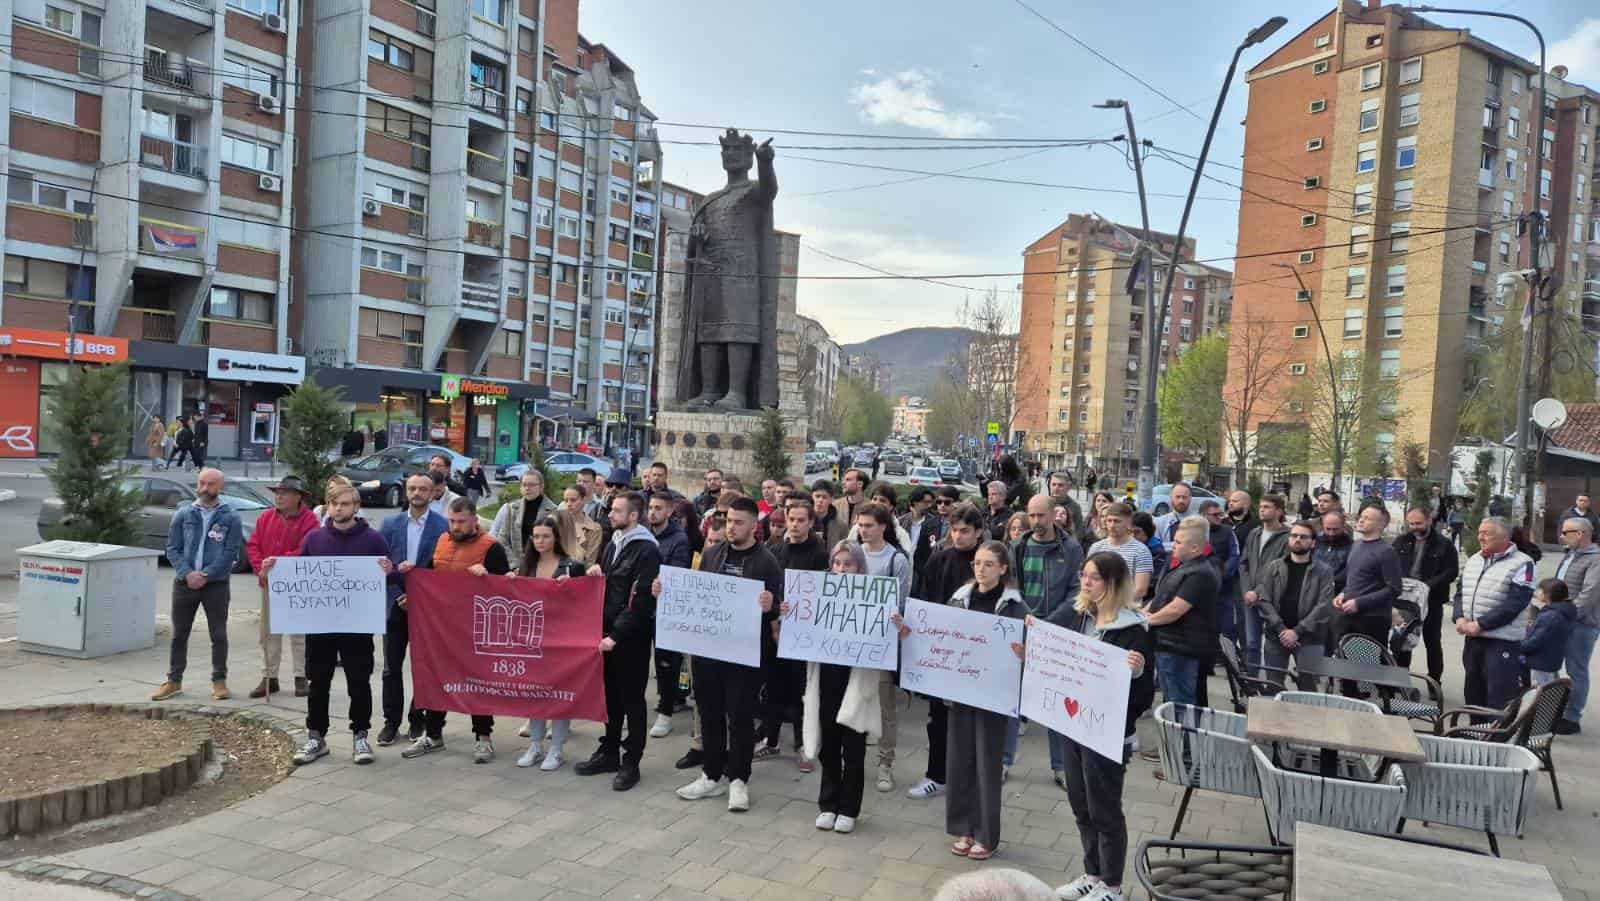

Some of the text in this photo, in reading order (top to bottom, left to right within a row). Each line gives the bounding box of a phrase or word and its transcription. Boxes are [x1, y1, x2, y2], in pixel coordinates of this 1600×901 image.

[86, 343, 116, 355] BPB
[461, 379, 510, 395] Meridian
[295, 560, 345, 577] НИЈЕ
[271, 578, 382, 595] ФИЛОЗОФСКИ
[724, 581, 737, 594] СЕ
[787, 571, 898, 605] ИЗ БАНАТА
[785, 599, 813, 622] ИЗ
[491, 659, 527, 677] 1838
[443, 682, 519, 697] ФИЛОЗОФСКИ
[1079, 702, 1106, 730] КМ
